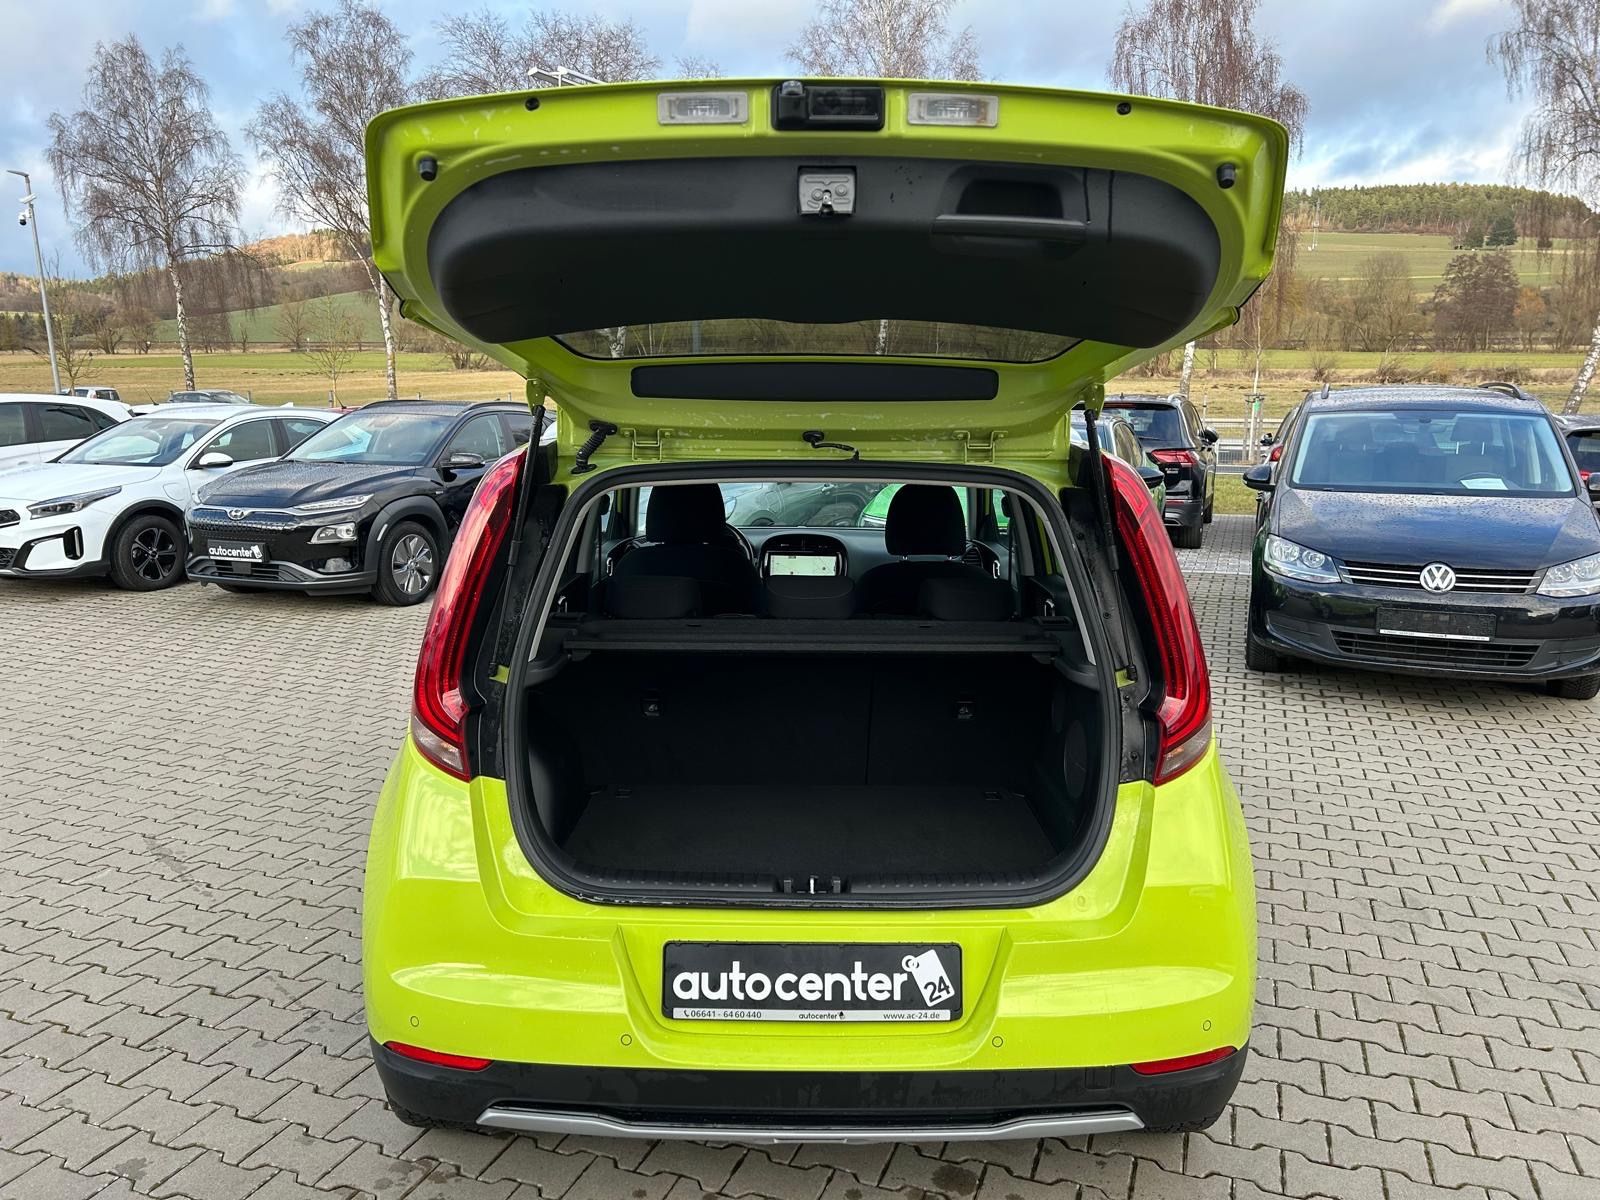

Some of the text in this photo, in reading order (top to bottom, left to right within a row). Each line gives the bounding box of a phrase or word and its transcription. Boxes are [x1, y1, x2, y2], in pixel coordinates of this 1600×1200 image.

[209, 545, 252, 557] autocenter
[672, 961, 951, 1003] autocenter 24
[690, 1009, 716, 1018] 06641
[798, 1012, 838, 1020] autocenter
[883, 1012, 941, 1020] www.ac-24.de
